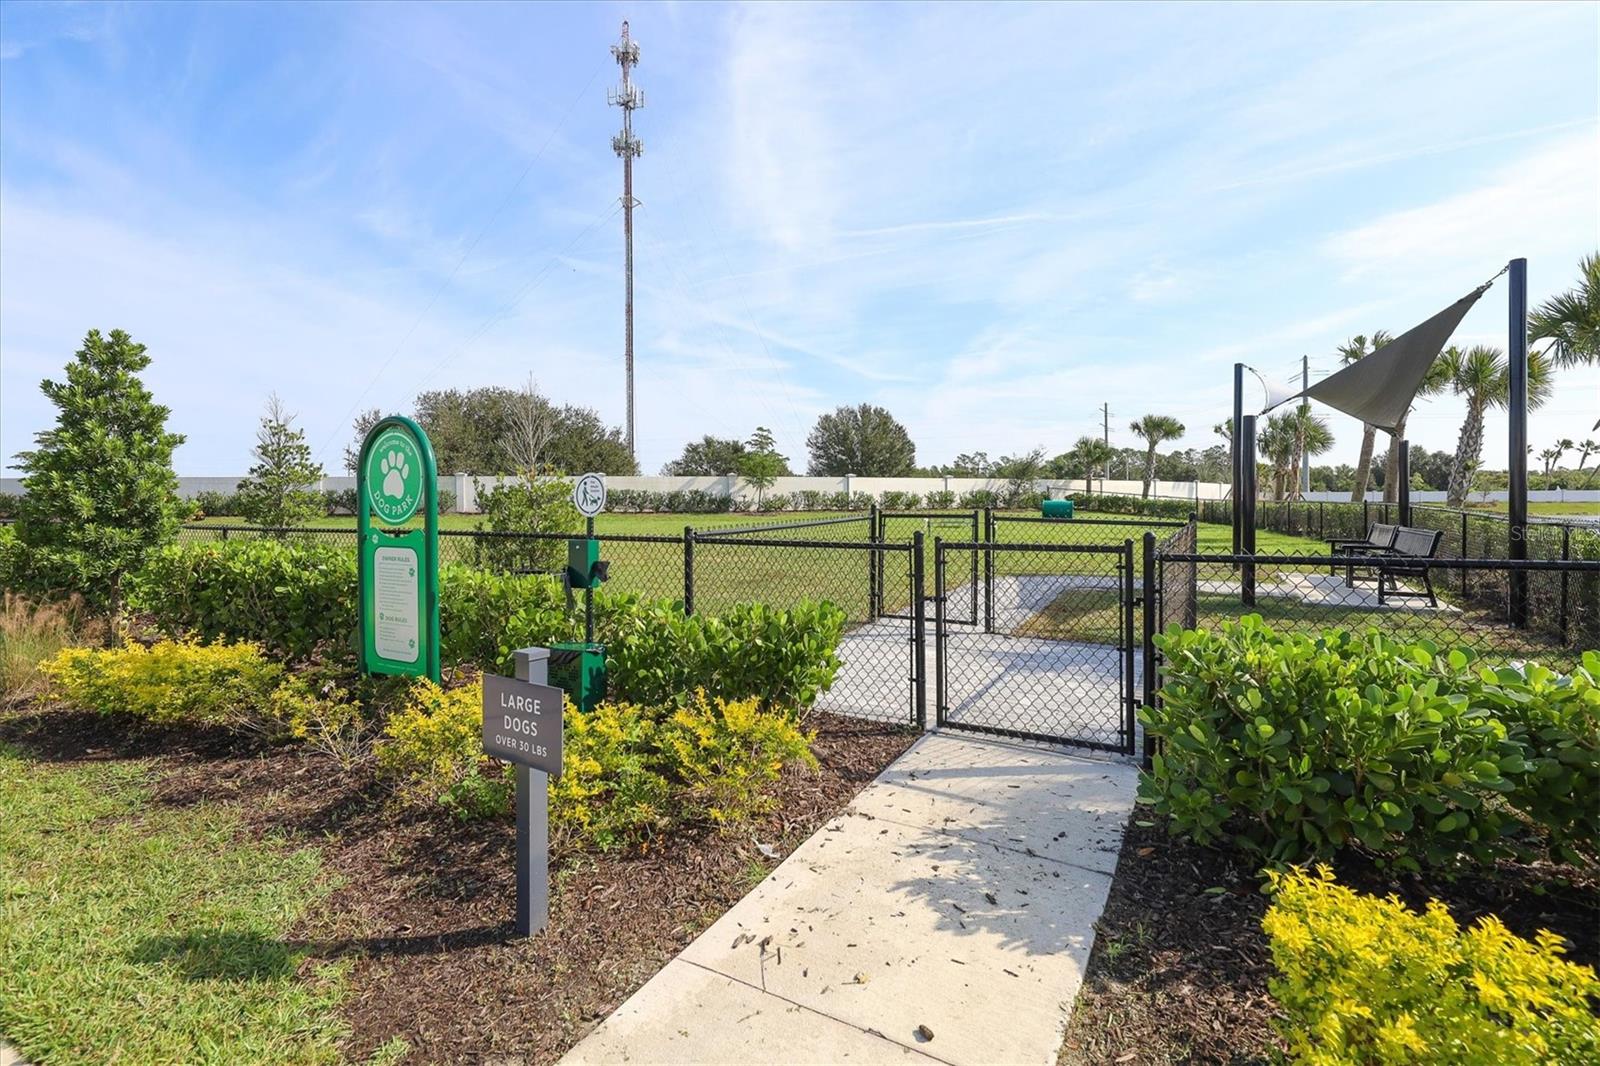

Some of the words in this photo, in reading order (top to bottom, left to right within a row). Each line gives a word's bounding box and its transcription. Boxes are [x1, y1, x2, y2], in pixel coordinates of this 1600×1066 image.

[374, 490, 390, 514] DOG
[392, 494, 413, 515] PARK
[501, 692, 541, 715] LARGE
[504, 715, 538, 737] DOGS
[495, 734, 517, 749] OVER
[519, 740, 529, 752] 30
[531, 744, 547, 757] LBS
